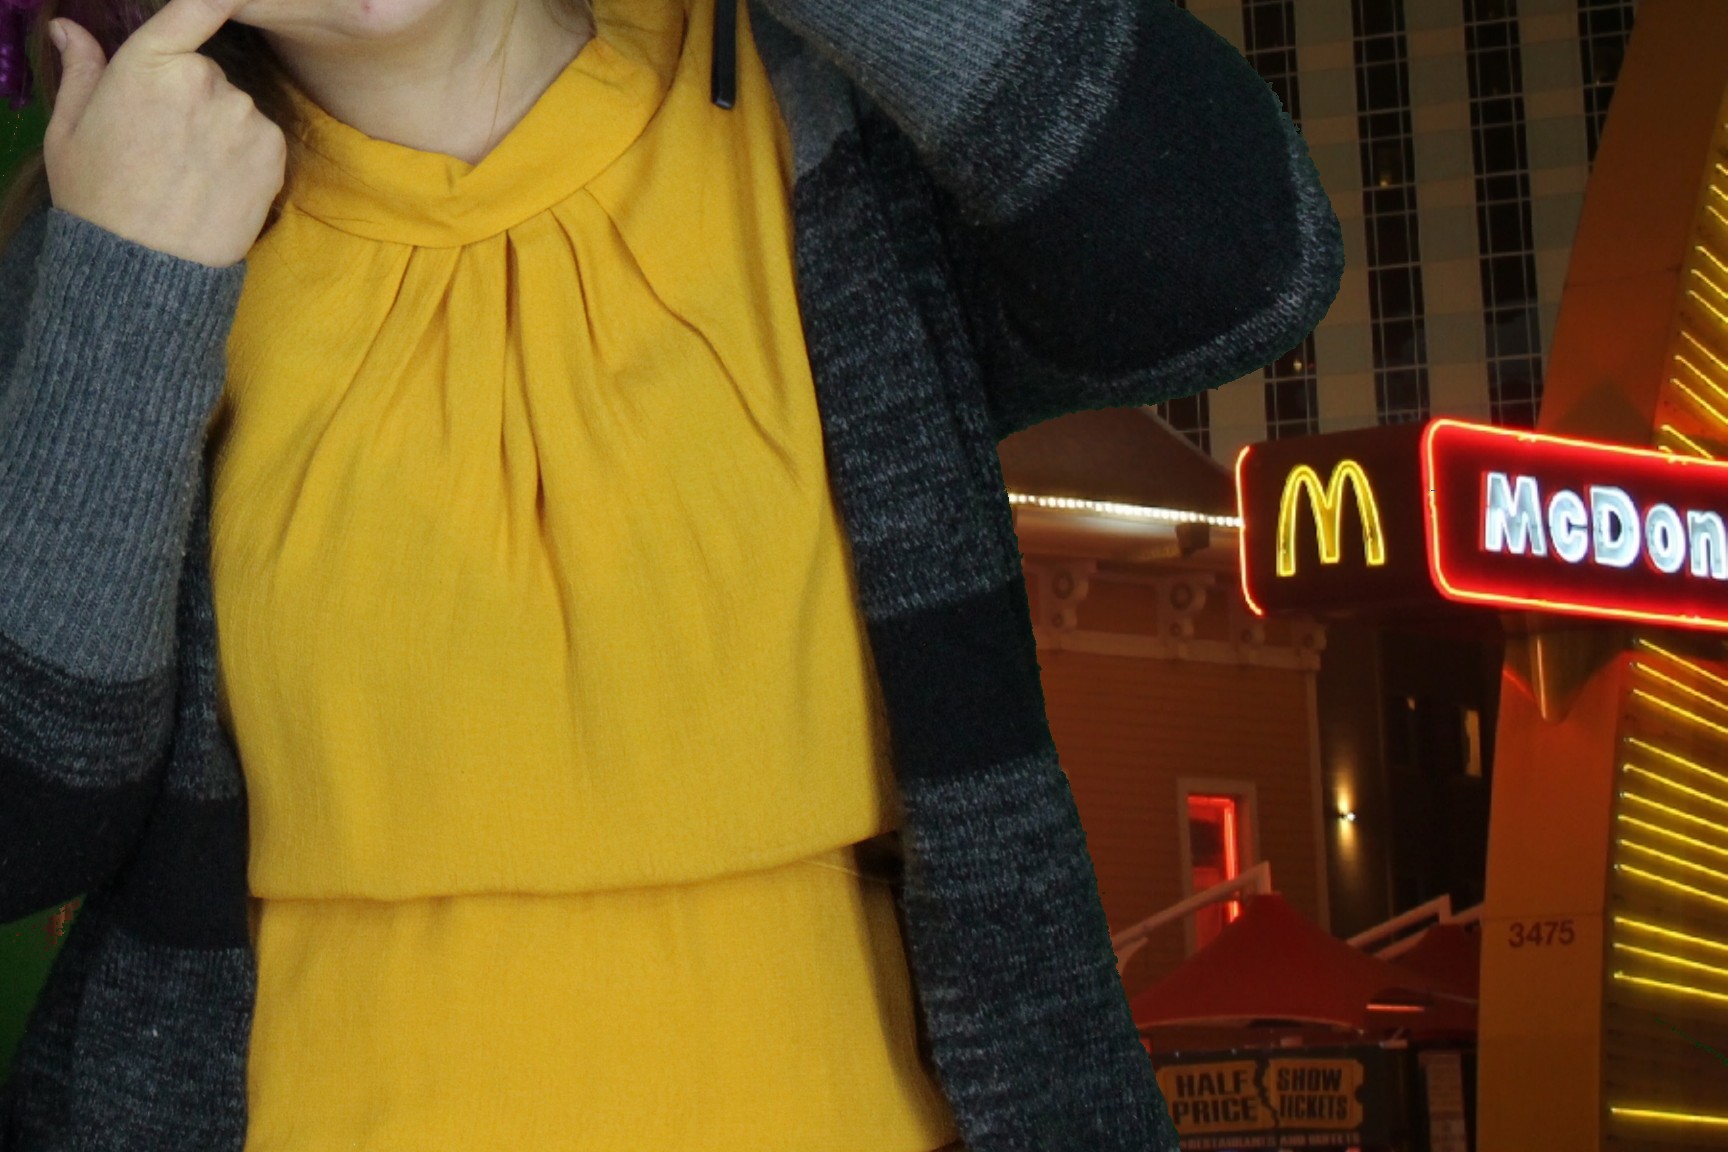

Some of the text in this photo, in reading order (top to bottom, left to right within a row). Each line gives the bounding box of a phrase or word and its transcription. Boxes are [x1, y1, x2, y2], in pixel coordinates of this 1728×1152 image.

[1483, 470, 1728, 580] McDon
[1507, 919, 1576, 948] 3475
[1175, 1069, 1249, 1098] HALF
[1276, 1067, 1343, 1093] SHOW
[1171, 1096, 1259, 1126] PRICE
[1278, 1093, 1348, 1121] TICKETS
